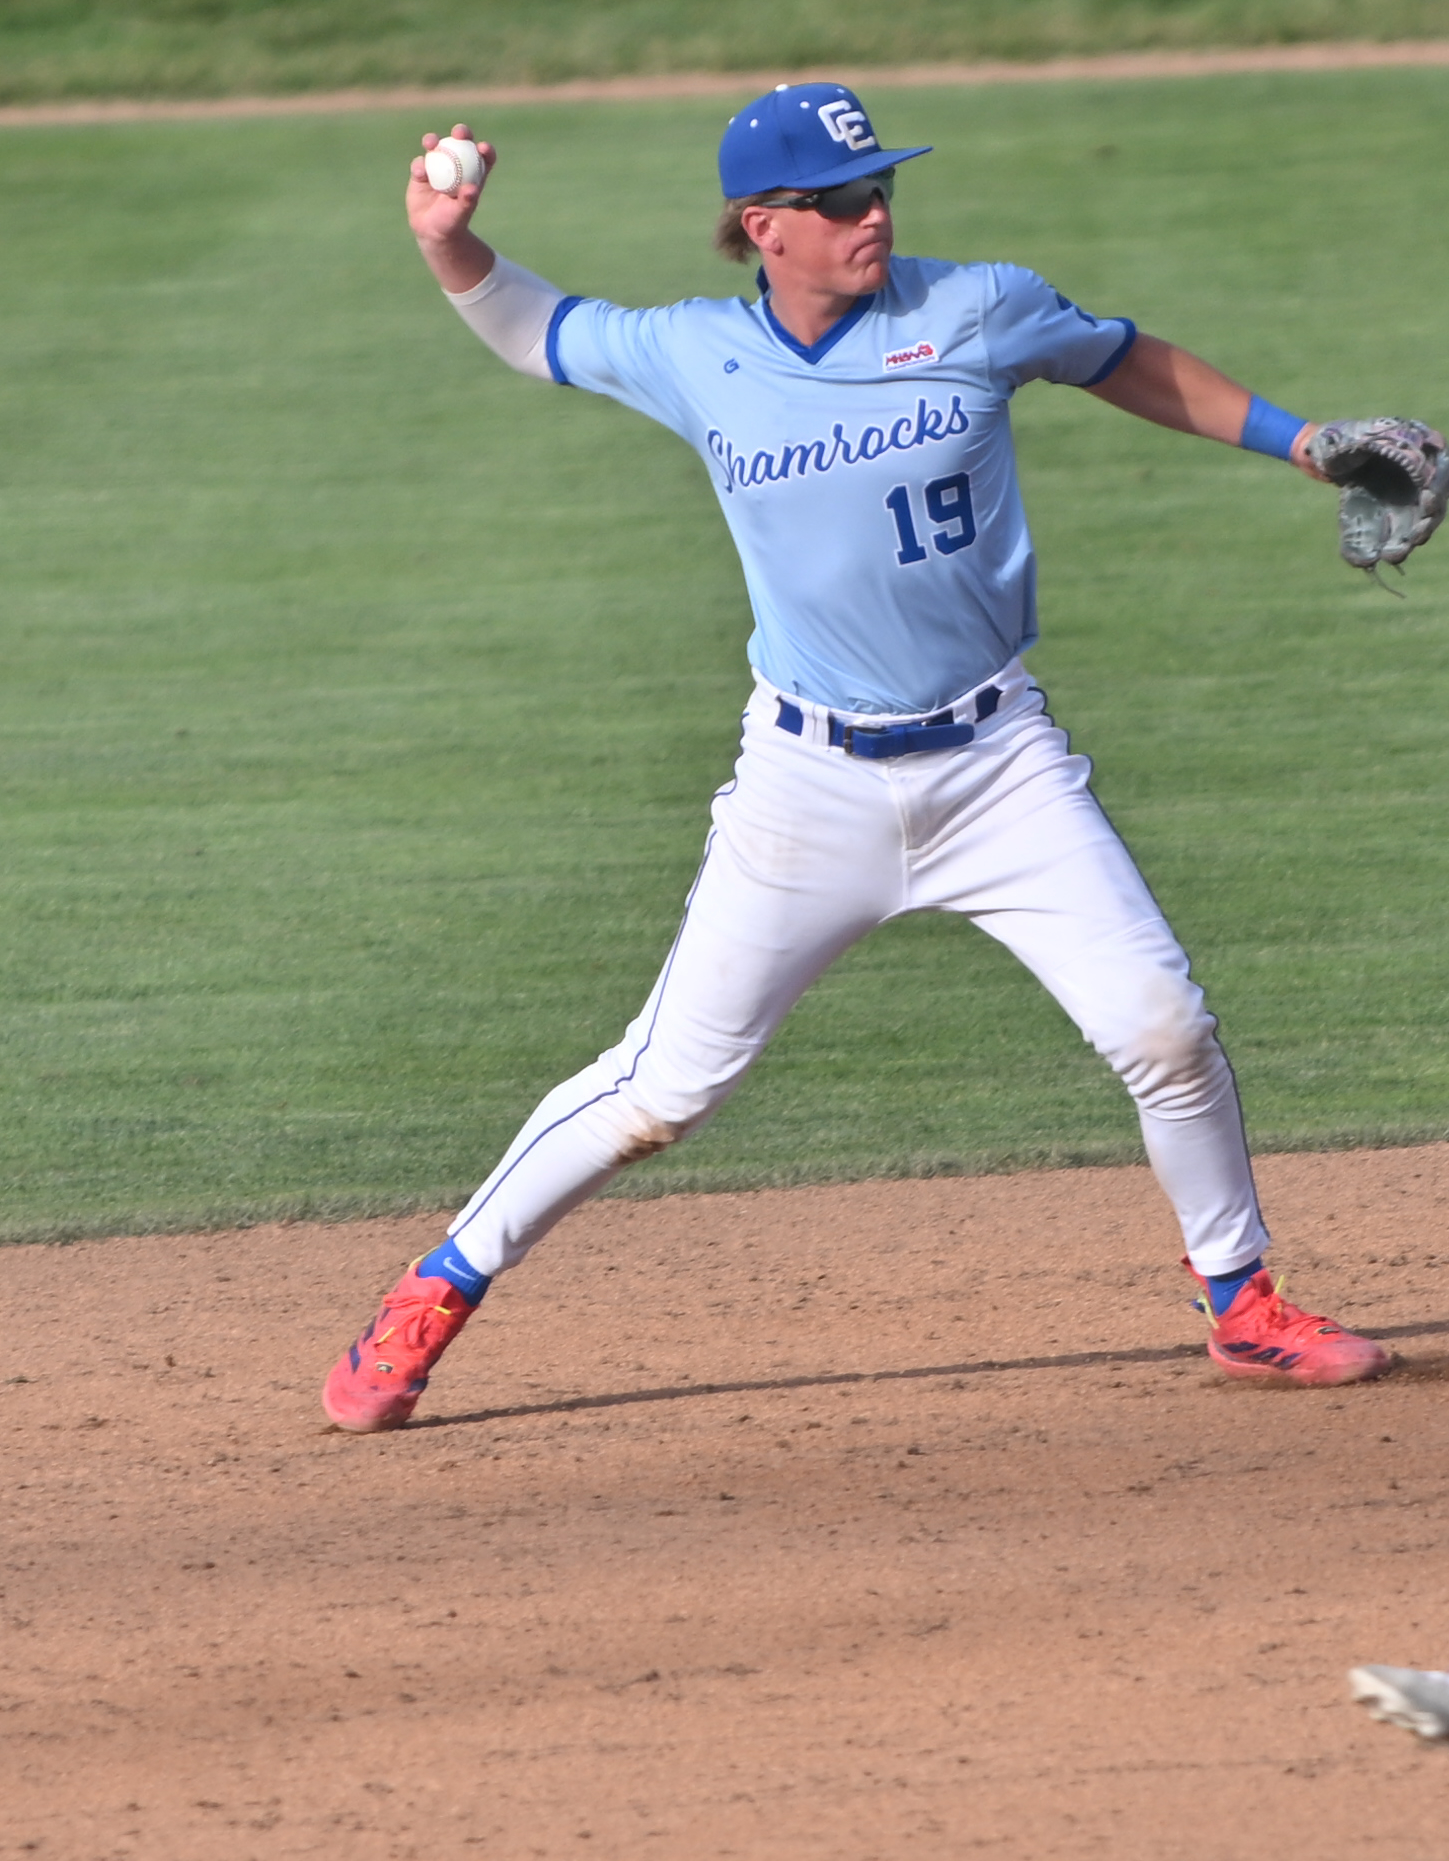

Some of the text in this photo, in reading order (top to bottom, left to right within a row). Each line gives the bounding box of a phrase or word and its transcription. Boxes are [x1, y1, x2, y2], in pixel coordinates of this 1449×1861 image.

[818, 100, 876, 151] CE
[706, 394, 970, 494] Shamrocks
[884, 470, 978, 567] 19
